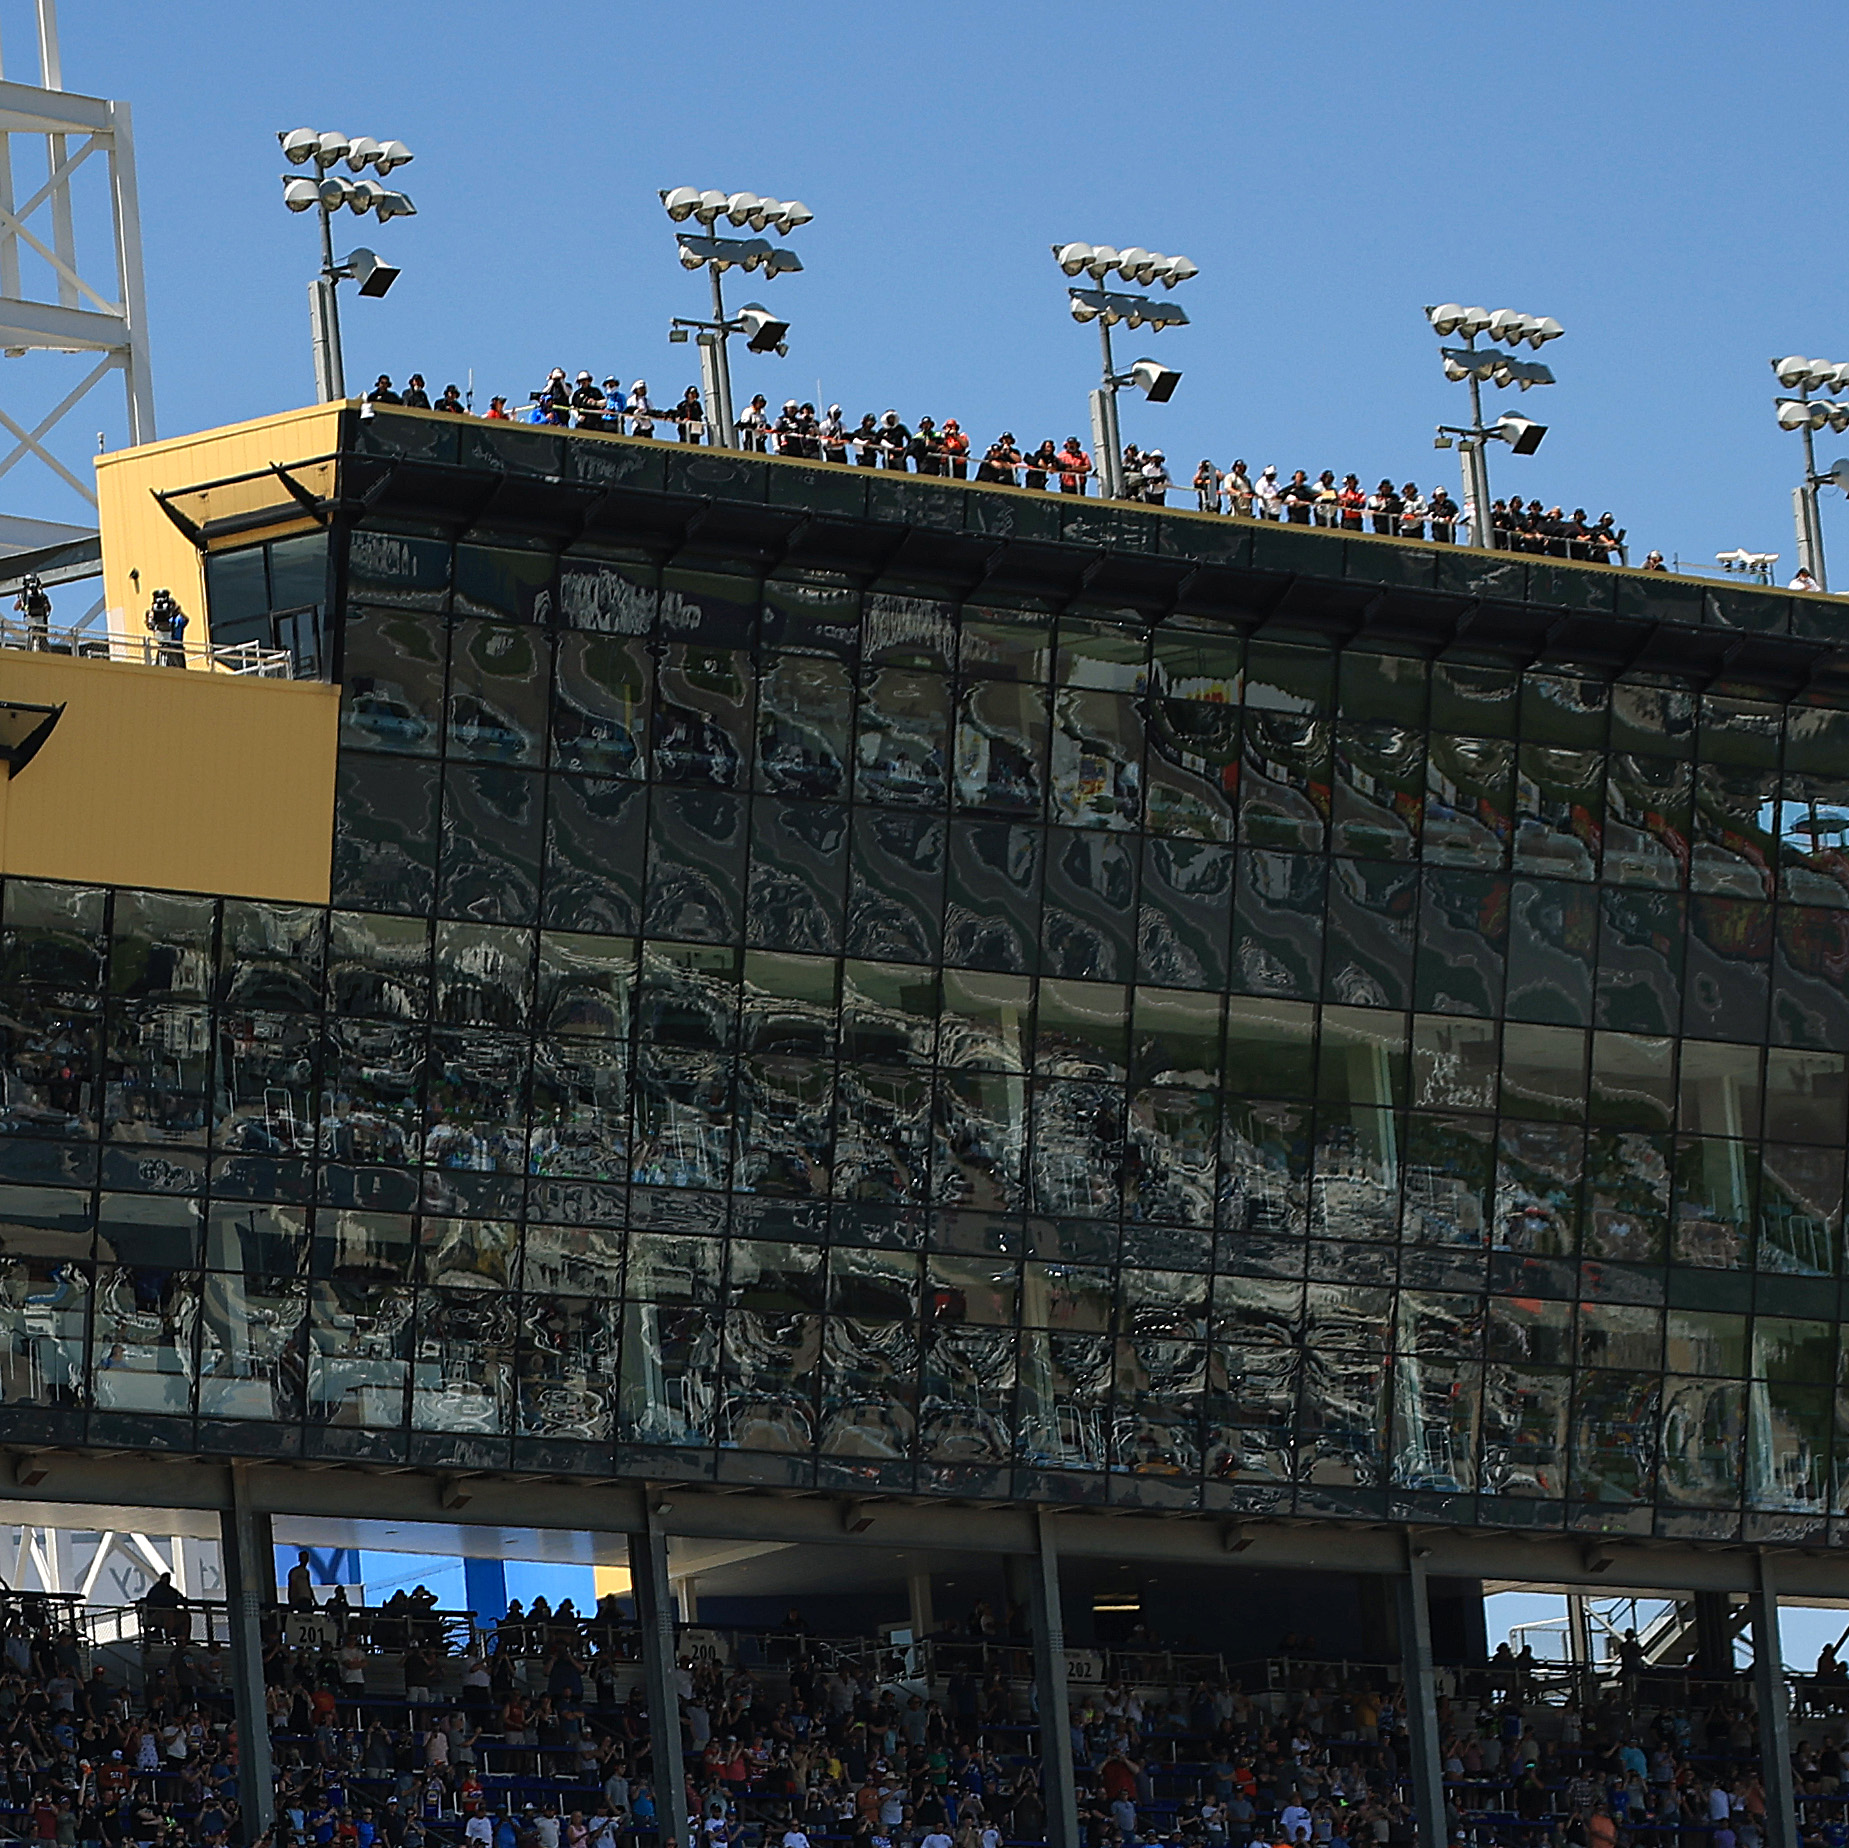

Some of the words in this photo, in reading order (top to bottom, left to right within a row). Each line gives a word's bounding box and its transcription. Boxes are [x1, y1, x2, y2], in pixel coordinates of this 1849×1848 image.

[299, 1625, 325, 1645] 201
[691, 1644, 717, 1661] 200
[1068, 1660, 1092, 1678] 202
